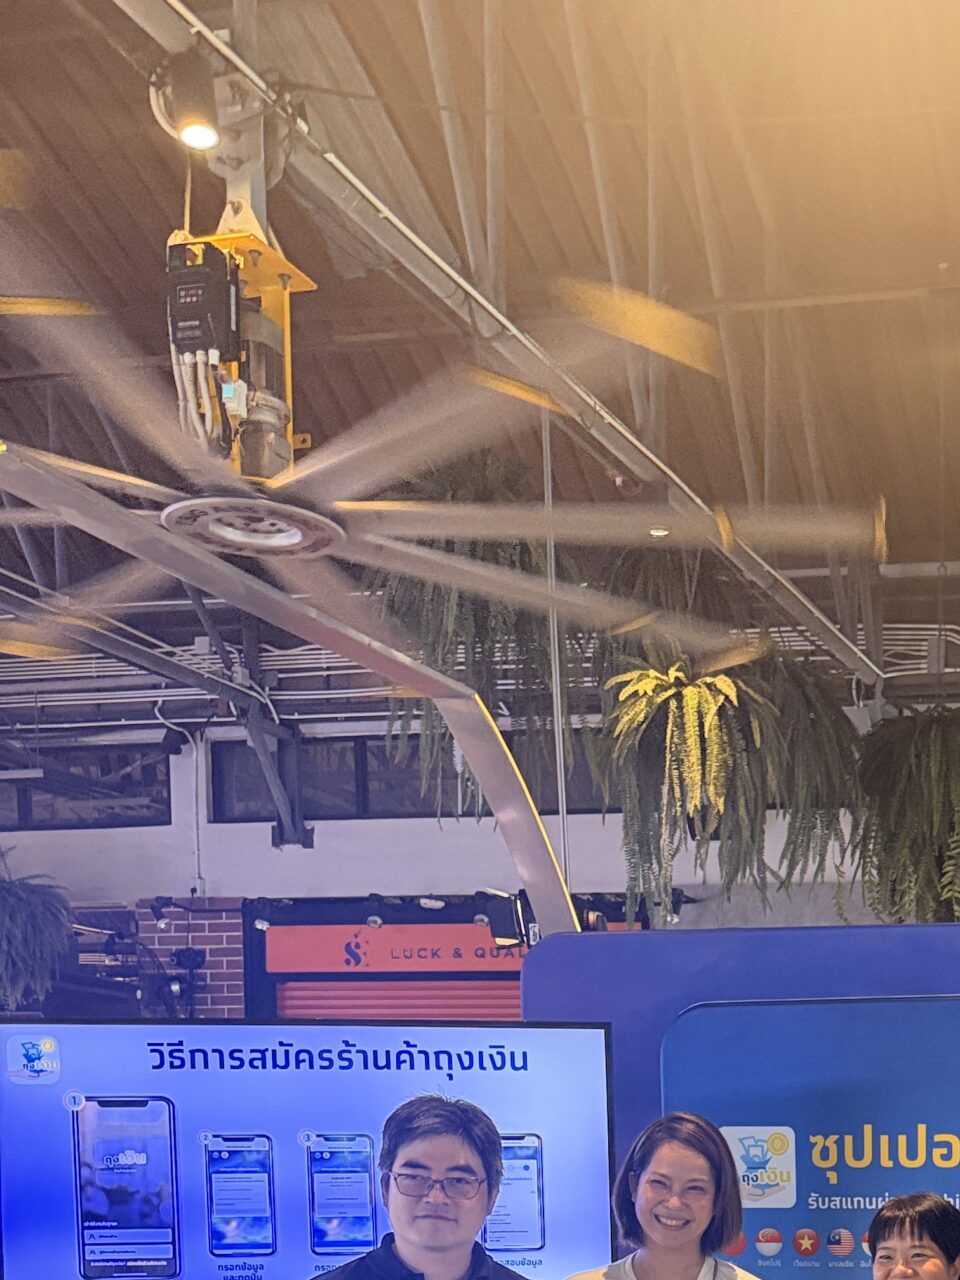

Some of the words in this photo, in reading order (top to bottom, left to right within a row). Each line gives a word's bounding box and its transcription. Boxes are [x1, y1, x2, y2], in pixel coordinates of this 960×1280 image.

[391, 948, 441, 960] LUCK
[147, 1040, 529, 1080] วิธีการสมัครร้านค้าถุงเงิน
[742, 1166, 791, 1186] ถุงเงิน
